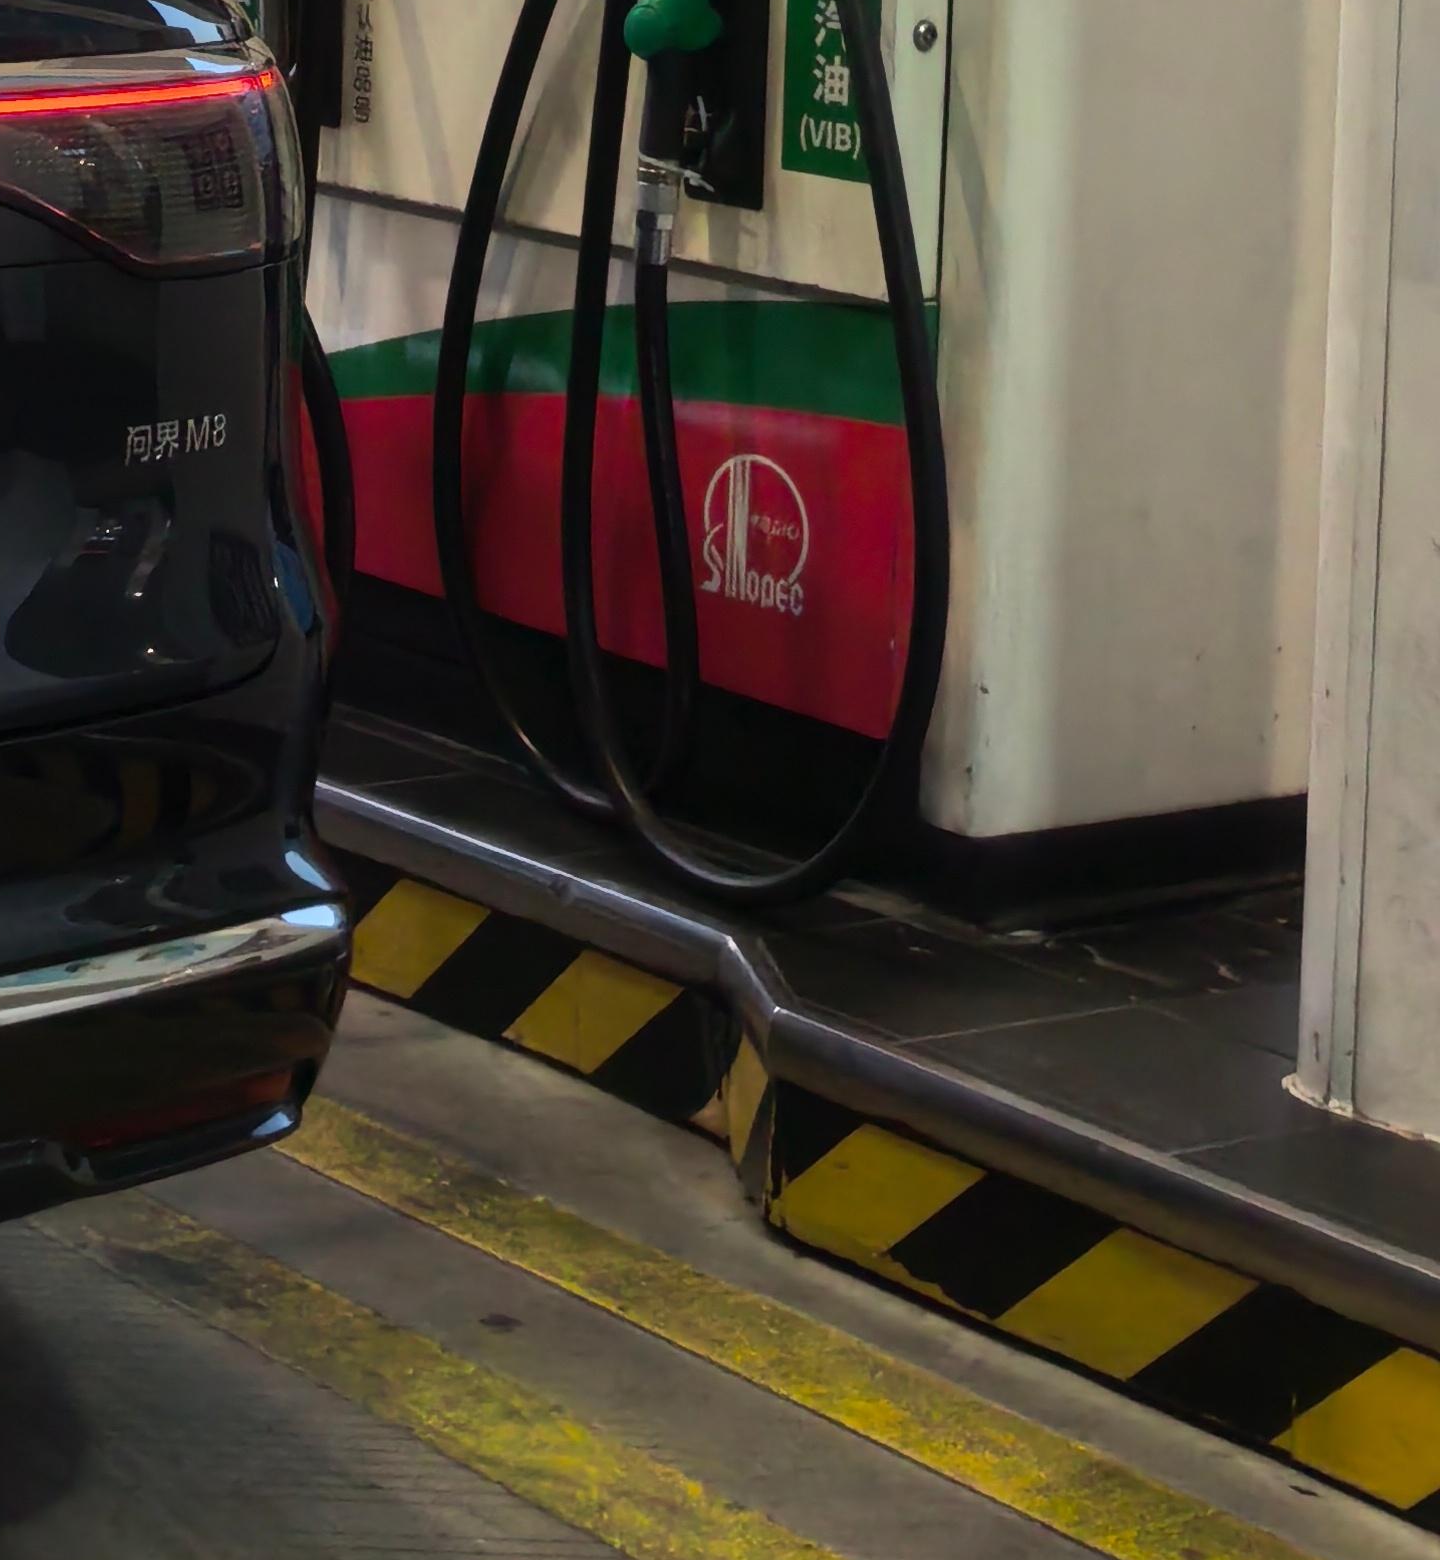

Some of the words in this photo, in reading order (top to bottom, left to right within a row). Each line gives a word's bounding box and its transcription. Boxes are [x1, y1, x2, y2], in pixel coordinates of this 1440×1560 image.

[799, 112, 862, 161] (VIB)
[124, 420, 180, 466] 问界
[185, 413, 227, 453] M8
